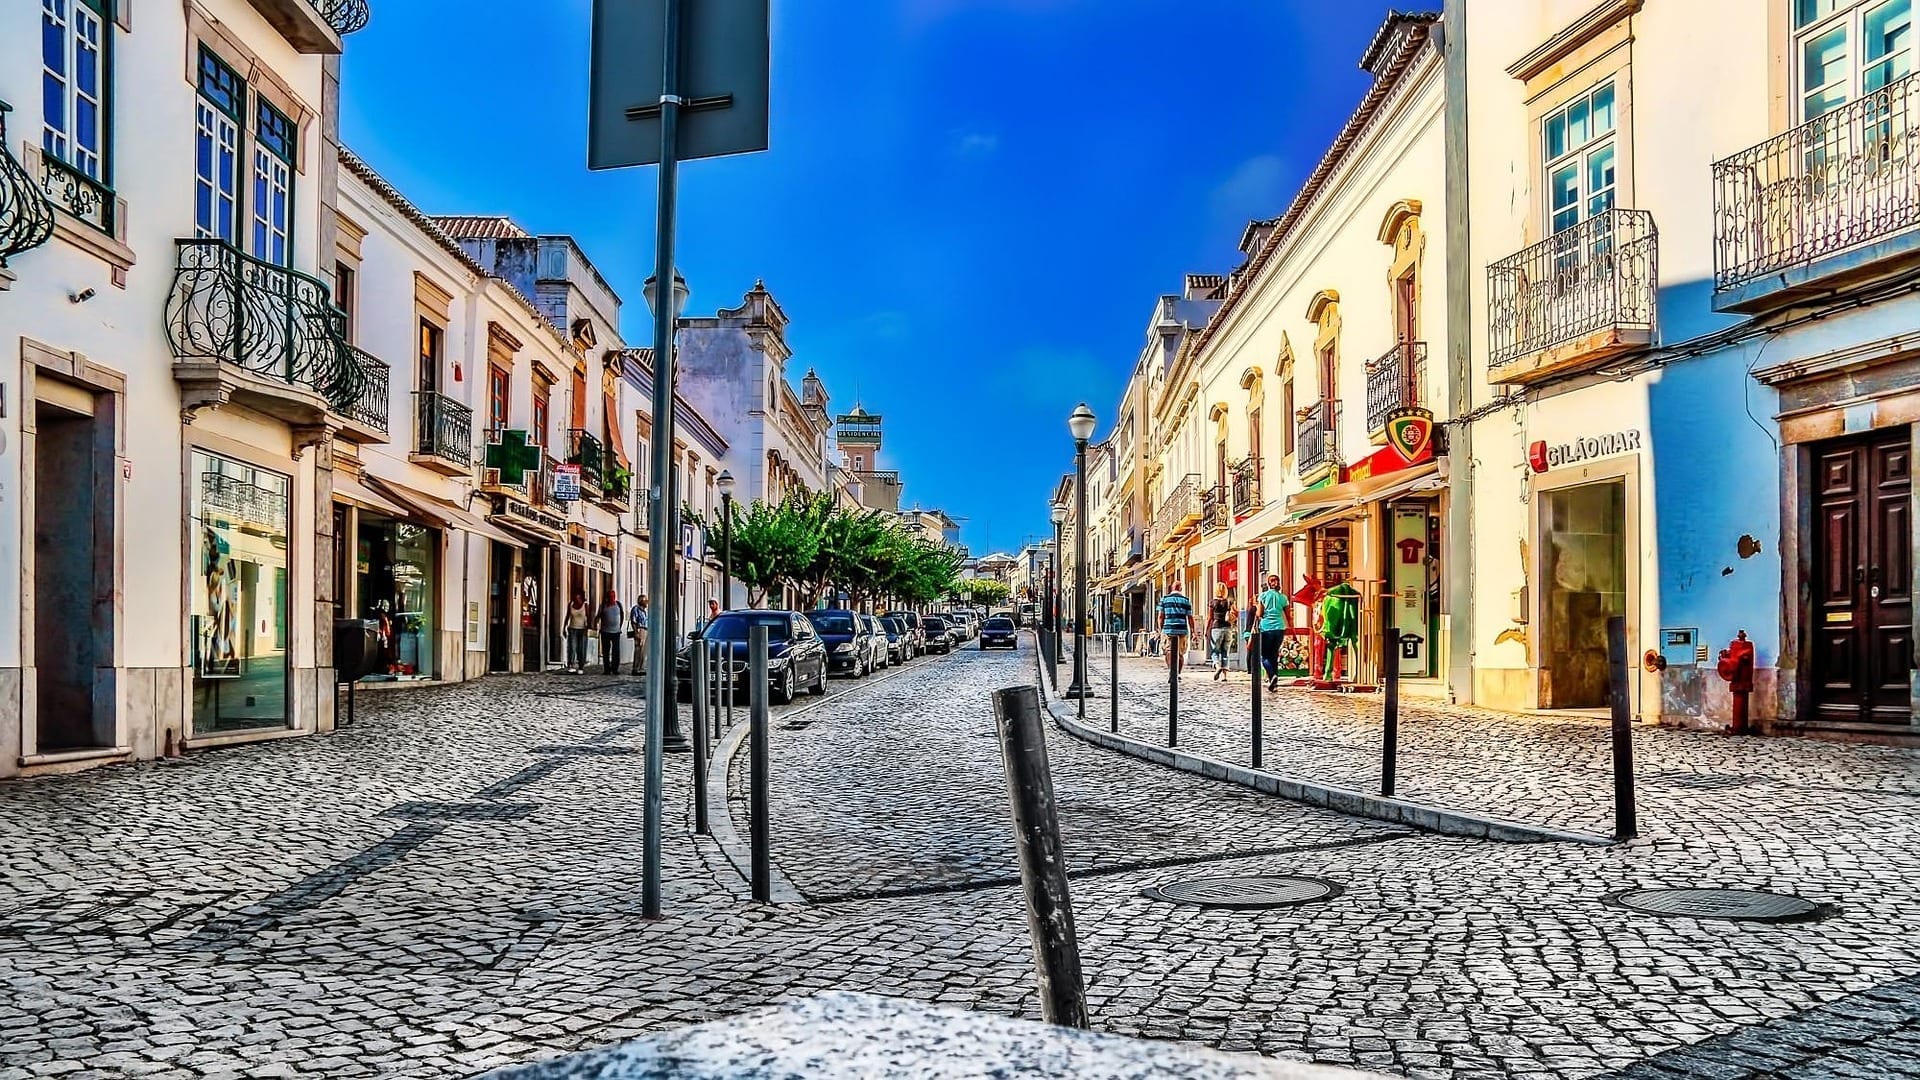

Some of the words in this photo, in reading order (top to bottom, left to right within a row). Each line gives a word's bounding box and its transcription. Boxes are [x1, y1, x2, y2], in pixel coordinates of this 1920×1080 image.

[1548, 428, 1641, 467] GILÃOMAR
[1407, 547, 1414, 559] 7
[1407, 642, 1414, 655] 9
